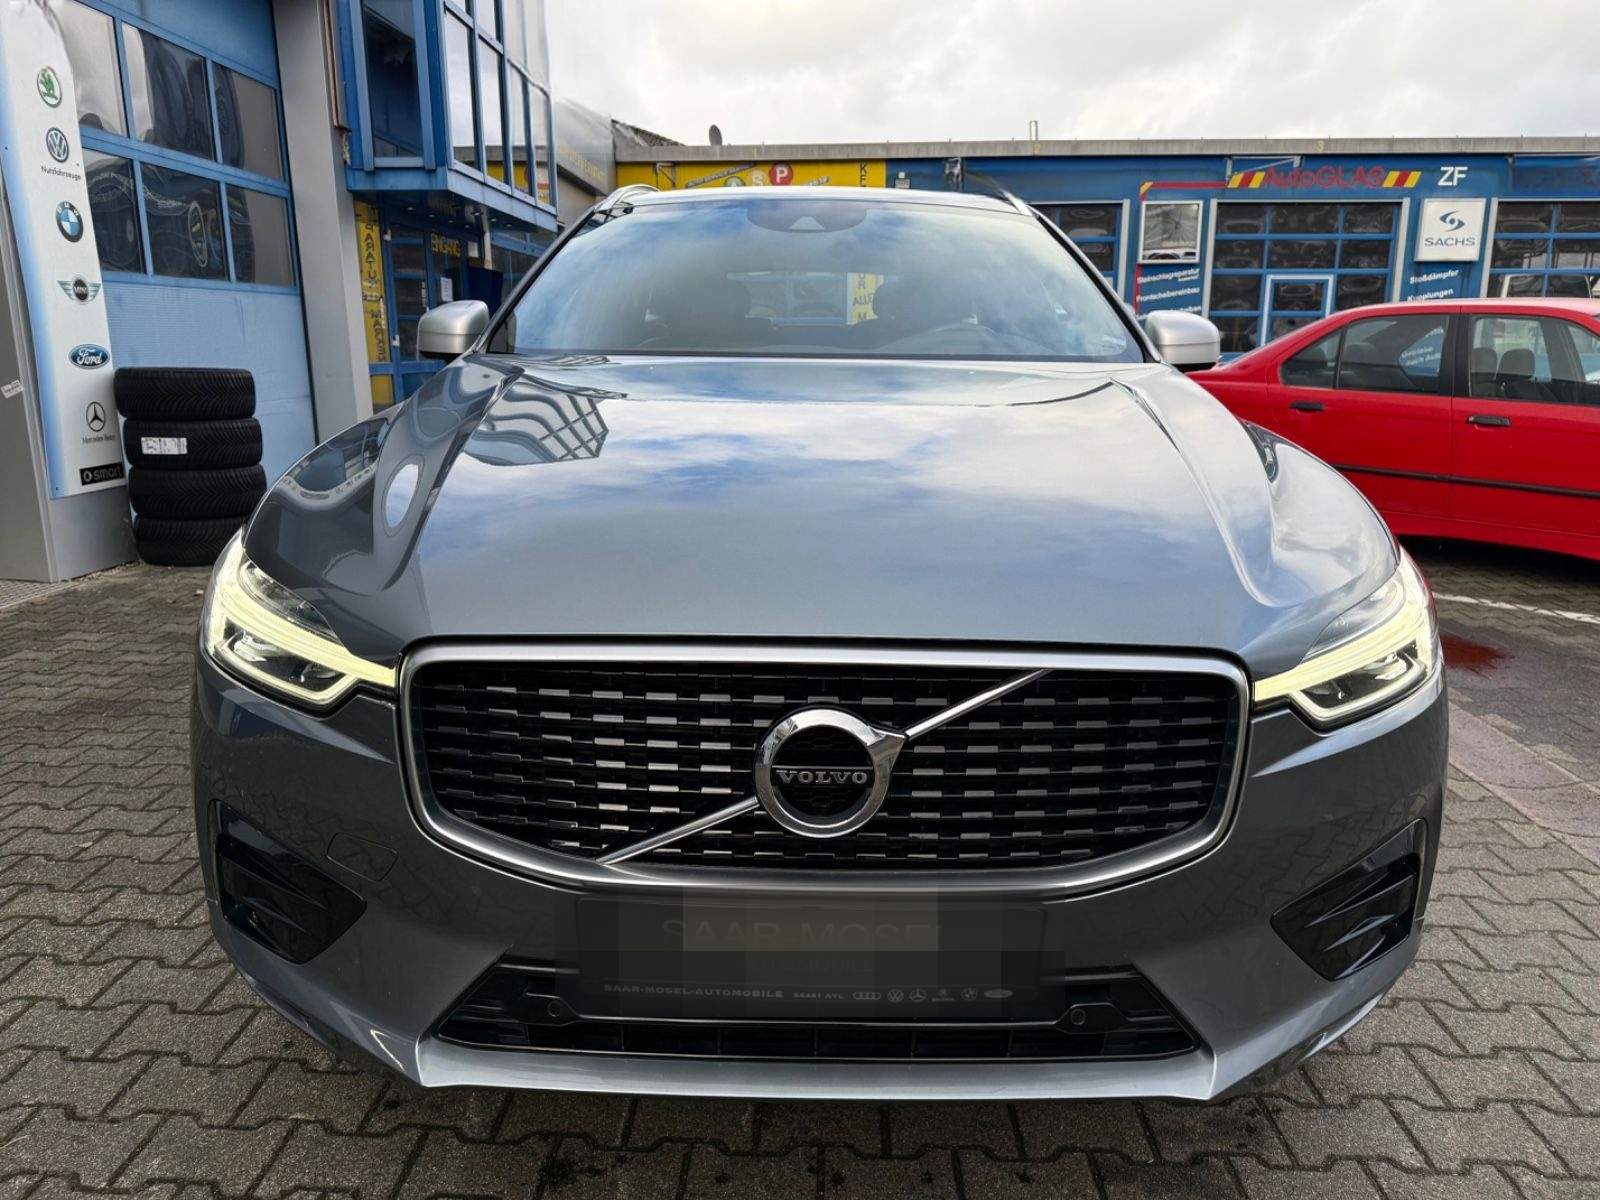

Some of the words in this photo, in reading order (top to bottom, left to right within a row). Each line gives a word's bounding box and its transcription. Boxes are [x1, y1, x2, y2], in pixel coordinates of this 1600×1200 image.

[776, 166, 789, 184] P
[859, 163, 868, 187] KF
[1262, 165, 1386, 189] AutoGLAS
[1438, 166, 1468, 186] ZF
[431, 233, 461, 257] EINGANG
[1424, 237, 1476, 247] SACHS
[1409, 269, 1460, 284] Stoßdämpfer
[77, 348, 103, 365] Ford
[93, 465, 123, 480] smart
[776, 770, 868, 784] VOLVO
[603, 984, 784, 998] SAAR-MOSEL-AUTOMOBILE
